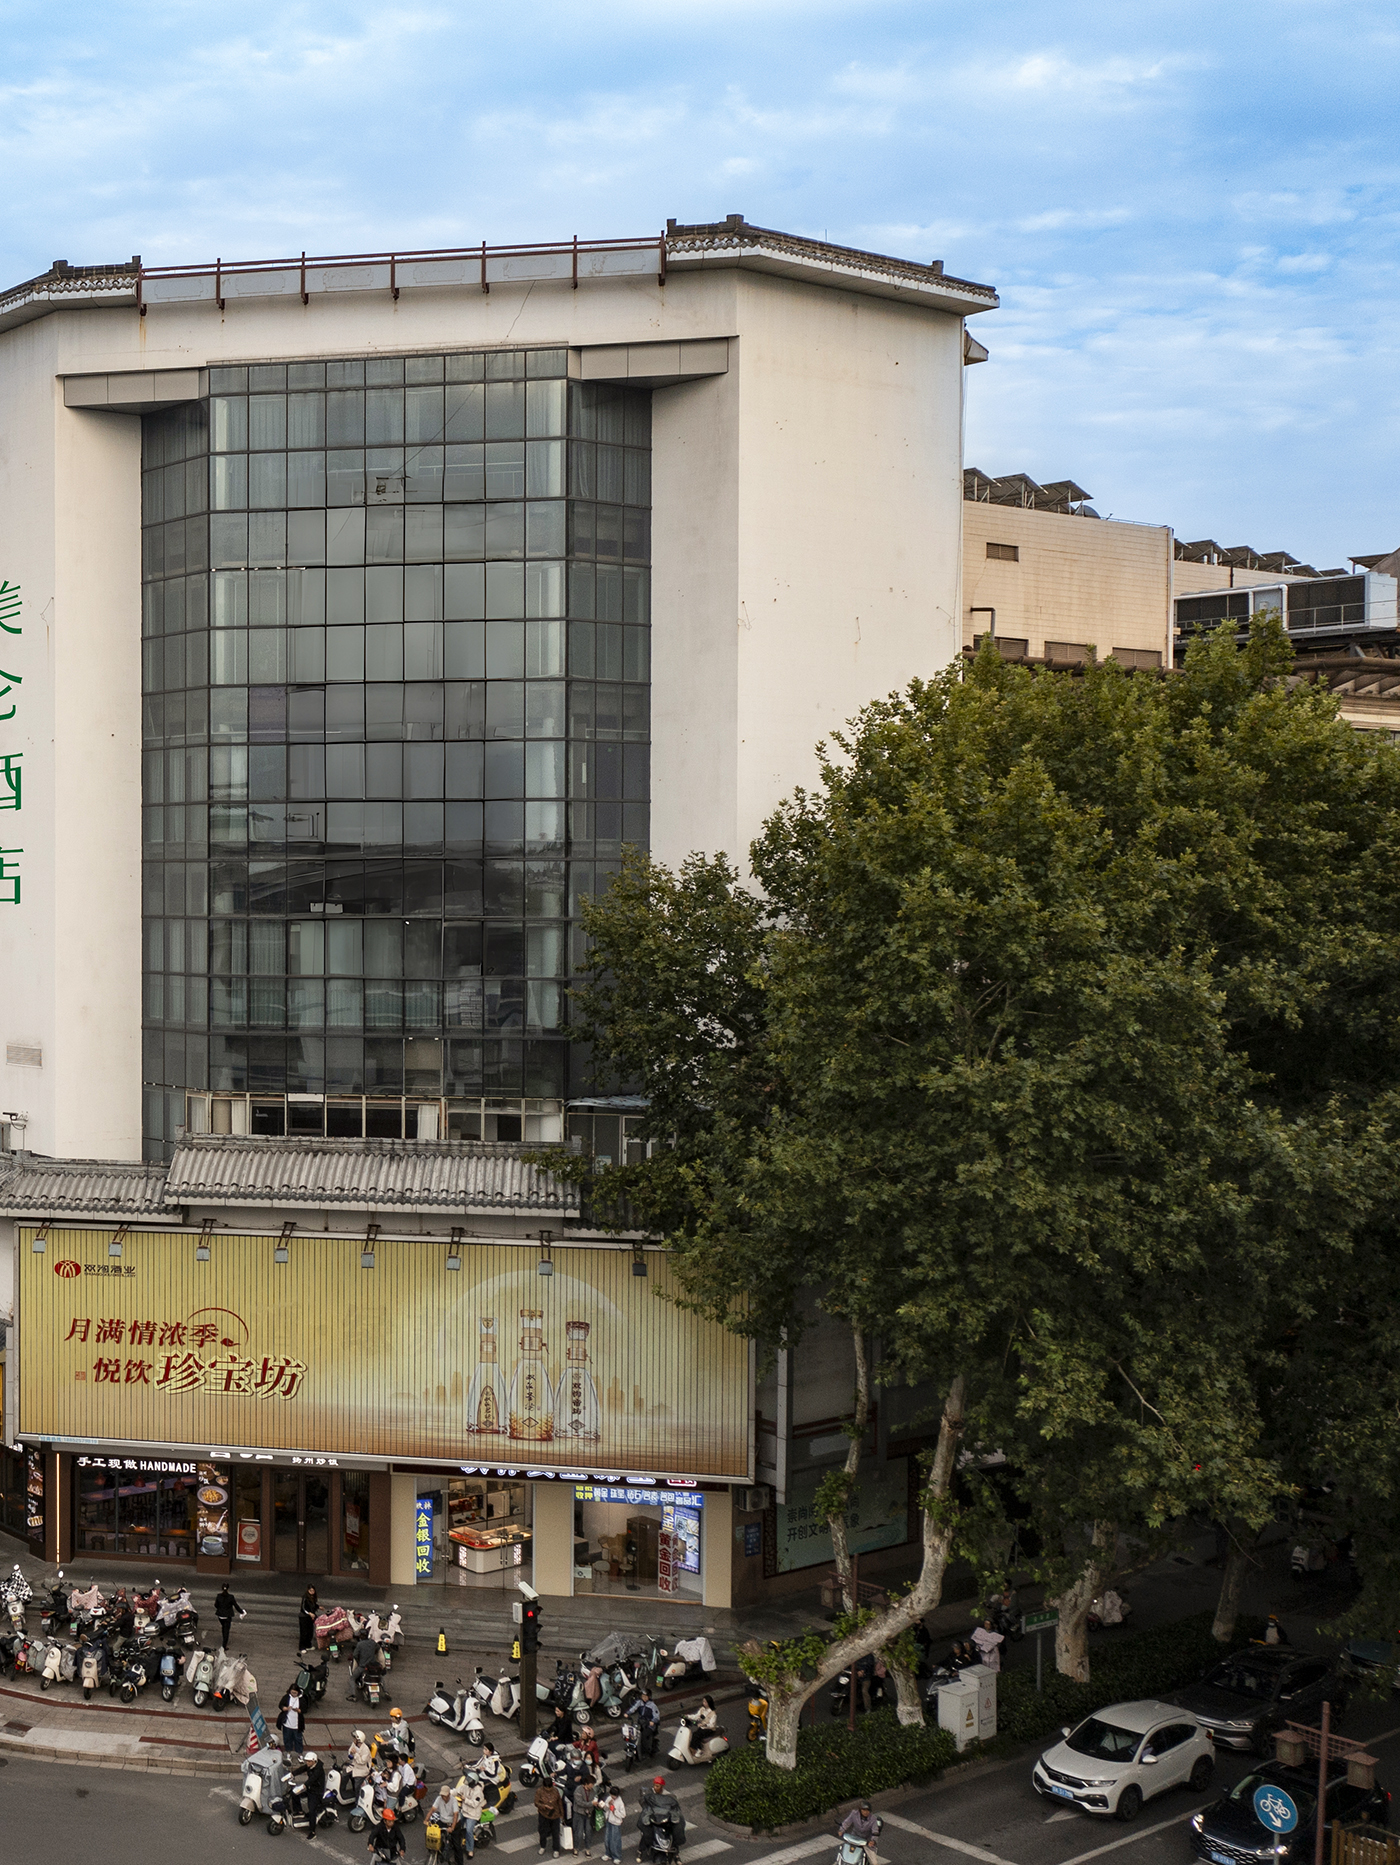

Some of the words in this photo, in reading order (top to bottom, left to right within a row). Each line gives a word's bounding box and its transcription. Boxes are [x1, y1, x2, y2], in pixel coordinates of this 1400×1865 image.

[64, 1316, 221, 1349] 月满情浓季
[76, 1456, 139, 1471] 手工现做
[140, 1460, 197, 1473] HANDMADE
[415, 1512, 432, 1574] 金银回收
[658, 1531, 672, 1593] 黄金回收
